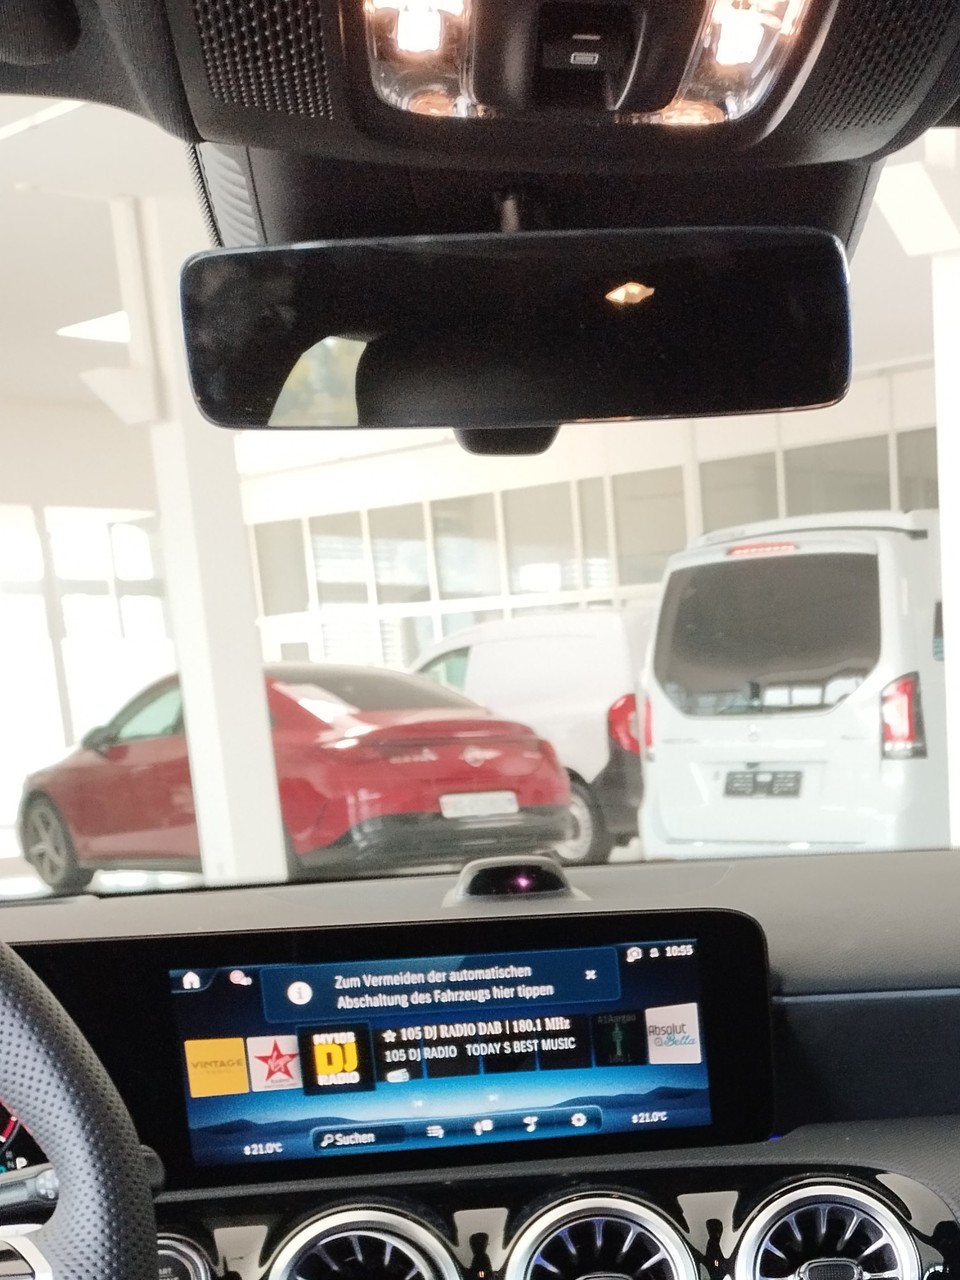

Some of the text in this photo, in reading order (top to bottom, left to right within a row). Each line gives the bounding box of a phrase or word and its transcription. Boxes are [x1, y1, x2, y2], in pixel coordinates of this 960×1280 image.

[665, 945, 694, 957] 10:55
[335, 965, 532, 989] Zum Vermeiden der automatischen
[337, 983, 555, 1009] Abschaltung des Fahrzeugs hier tippen
[400, 1026, 422, 1041] 105
[424, 1025, 437, 1040] DJ
[438, 1022, 477, 1039] RADIO
[478, 1020, 502, 1036] DAB
[512, 1018, 542, 1033] 180.1
[544, 1016, 571, 1031] MHz
[648, 1023, 687, 1036] Absolut
[314, 1042, 358, 1074] DJ
[384, 1048, 406, 1063] 105
[408, 1047, 421, 1061] DJ
[423, 1045, 458, 1060] RADIO
[466, 1042, 500, 1057] TODAY
[513, 1039, 539, 1053] BEST
[541, 1036, 576, 1051] MUSIC
[191, 1057, 244, 1069] VINTAGE
[335, 1132, 376, 1146] Suchen
